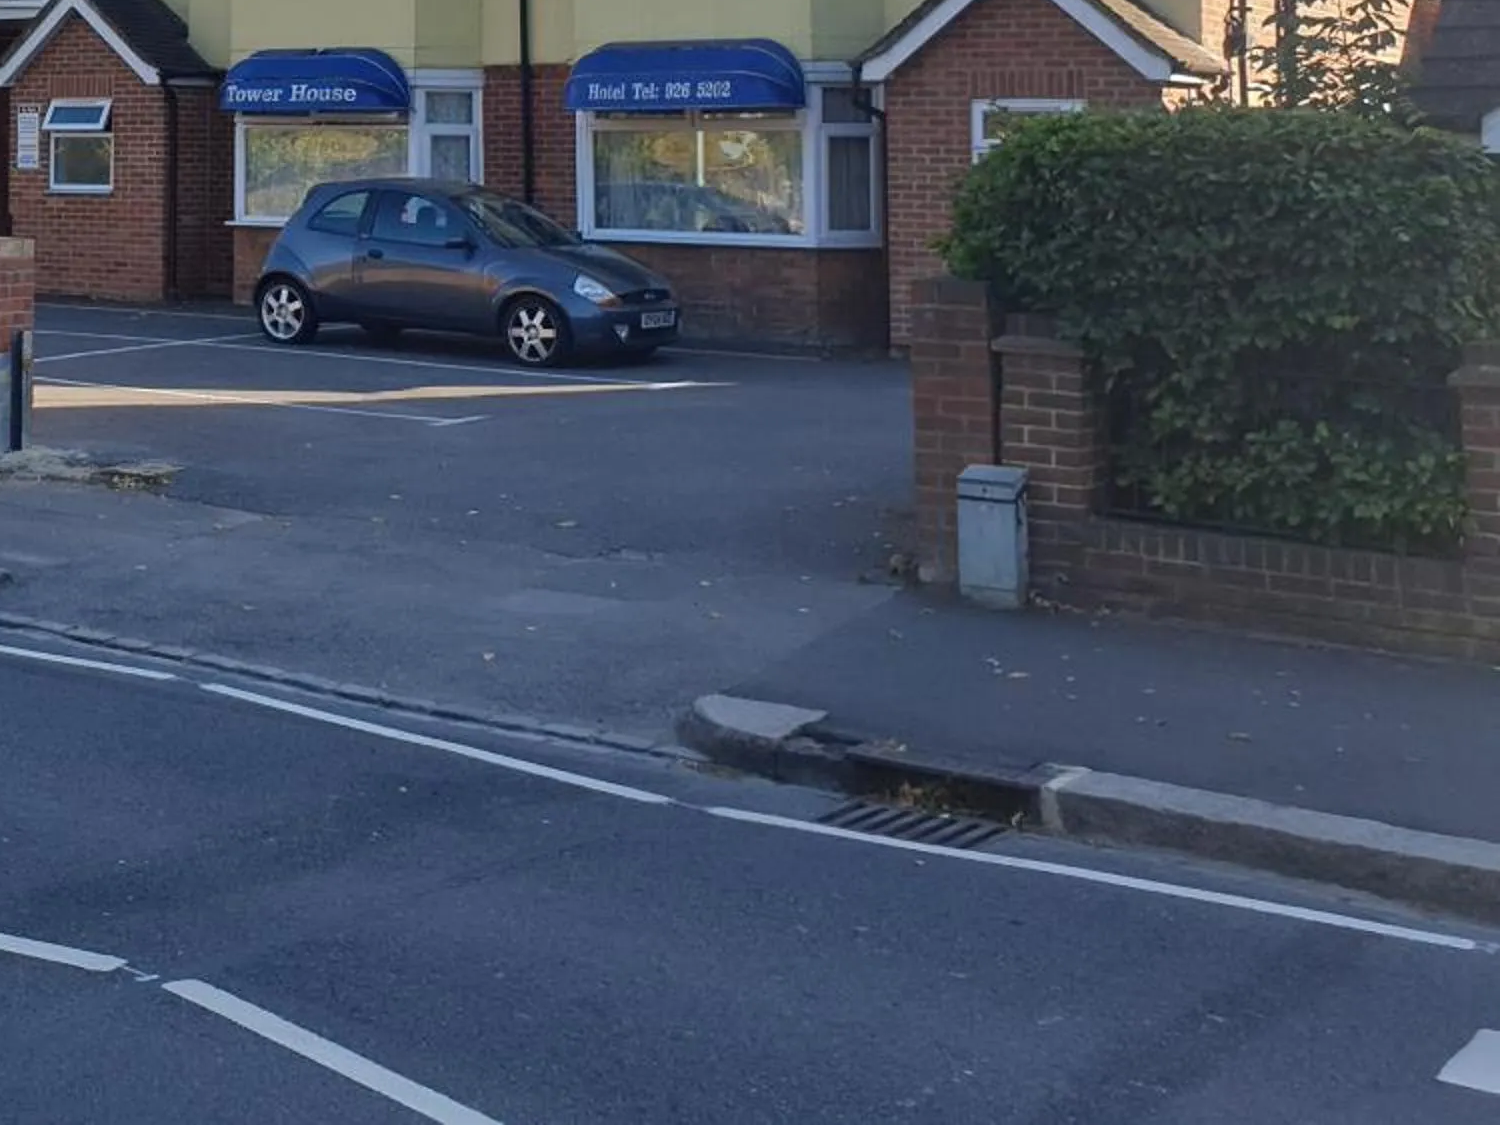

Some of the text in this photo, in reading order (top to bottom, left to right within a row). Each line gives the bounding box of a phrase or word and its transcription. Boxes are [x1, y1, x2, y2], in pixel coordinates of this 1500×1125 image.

[227, 84, 357, 102] Tower House
[588, 83, 625, 100] Hotel
[632, 82, 660, 100] Tel:
